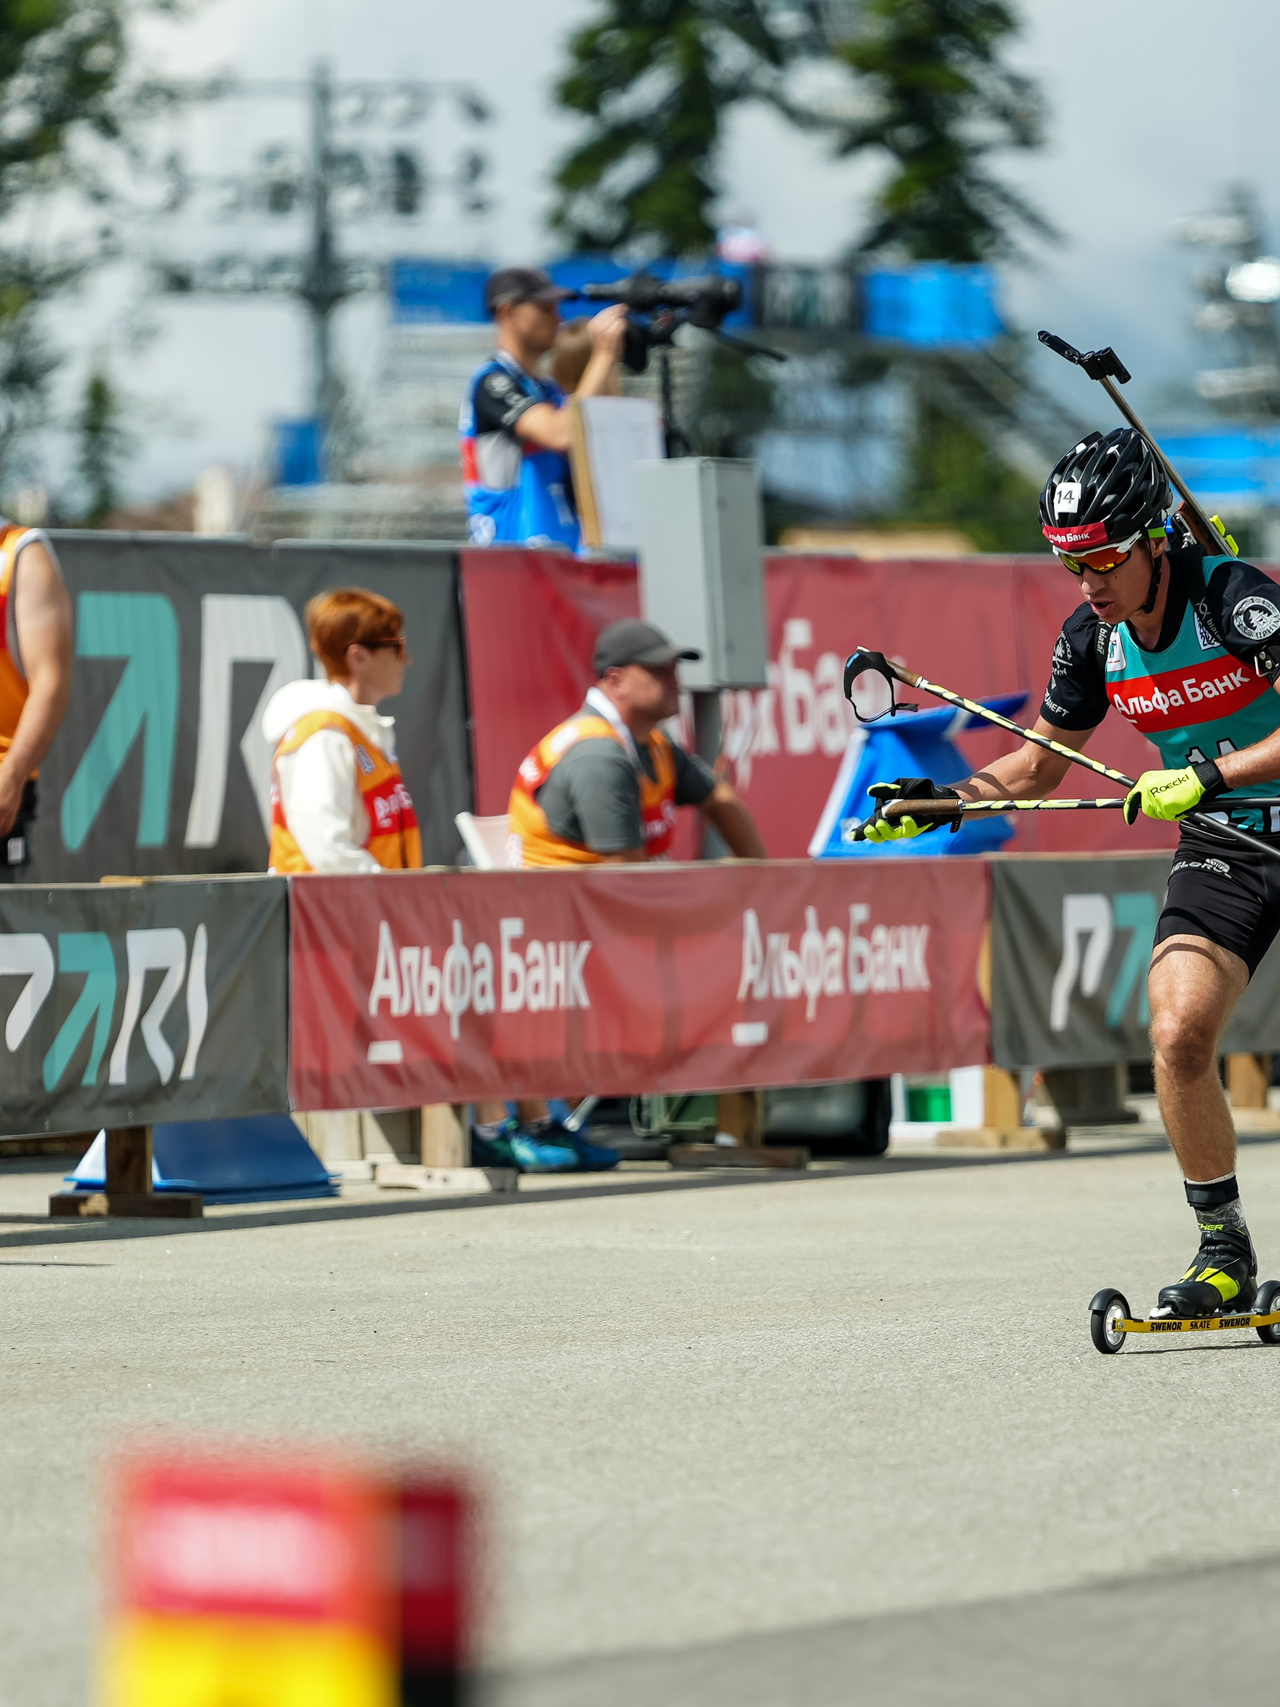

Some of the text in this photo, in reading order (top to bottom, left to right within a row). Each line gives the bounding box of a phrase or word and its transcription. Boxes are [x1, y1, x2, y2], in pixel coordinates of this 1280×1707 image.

[1056, 490, 1075, 505] 14
[1067, 532, 1090, 543] Банк
[1113, 667, 1251, 716] Альфа Банк
[368, 917, 592, 1040] Альфа Банк
[738, 903, 931, 1022] Альфа Банк
[1050, 889, 1168, 1033] PA
[1150, 1317, 1250, 1331] SWENOR SKATE SWENOR
